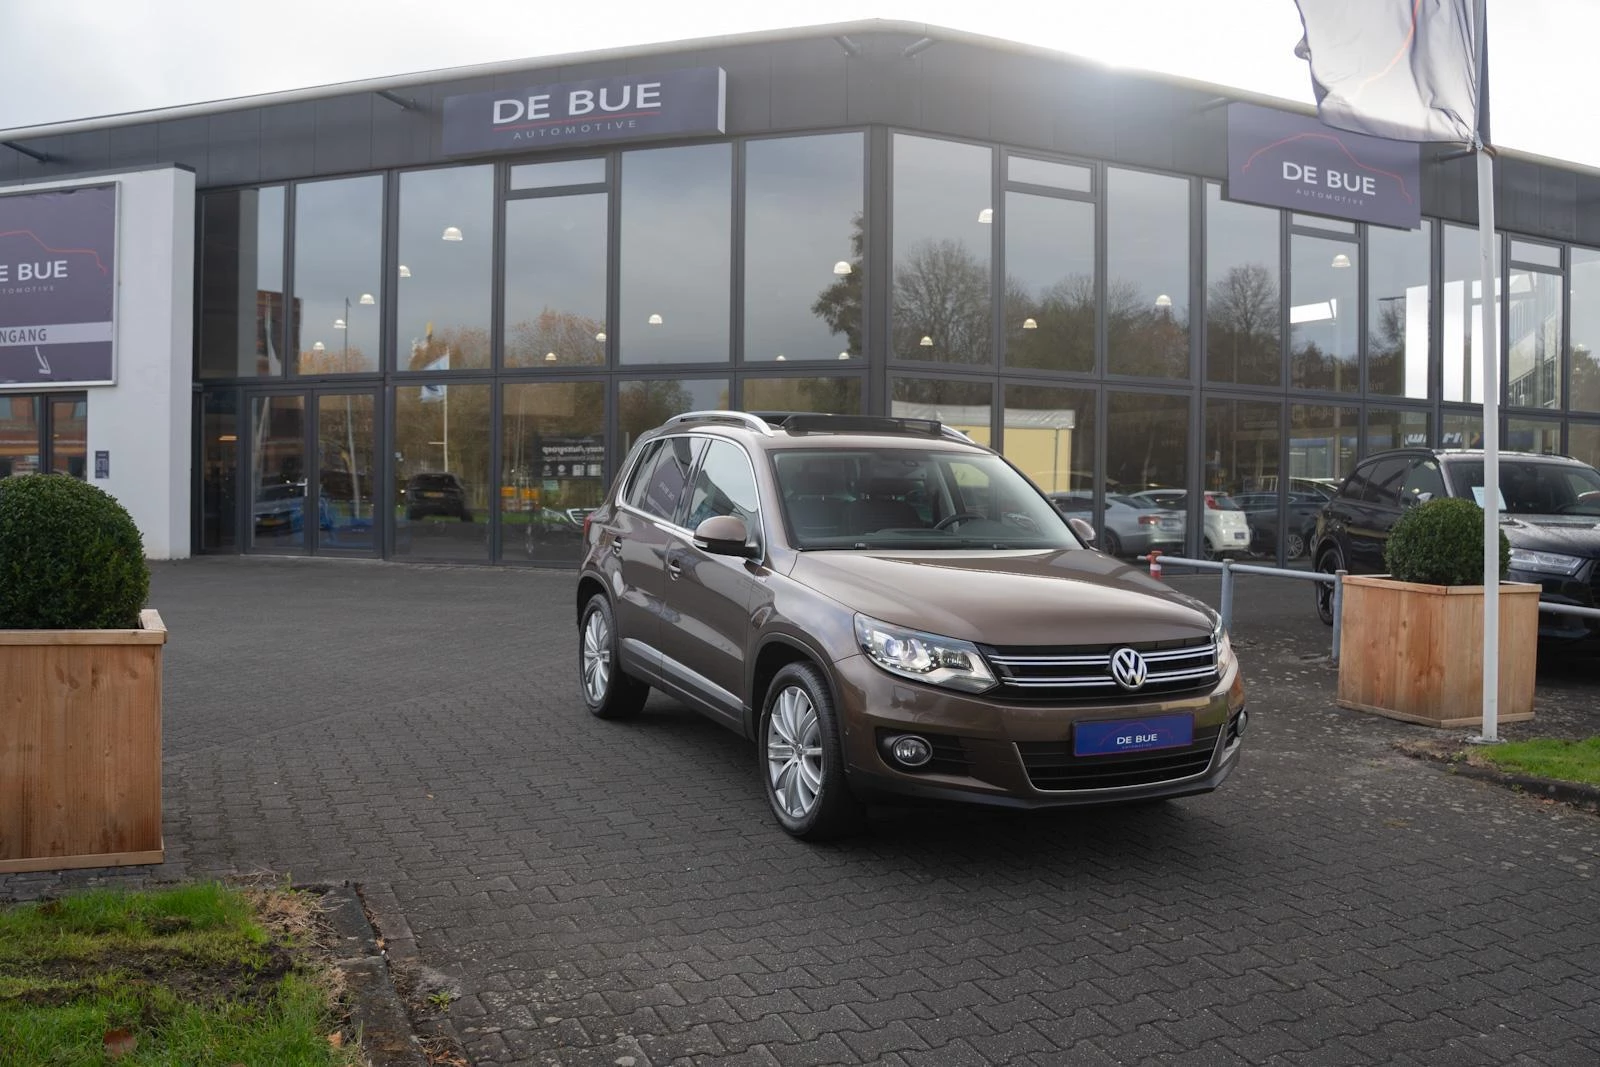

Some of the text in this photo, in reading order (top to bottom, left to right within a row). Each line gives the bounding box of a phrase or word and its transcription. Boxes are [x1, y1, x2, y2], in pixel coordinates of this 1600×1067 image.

[493, 82, 662, 124] DE BUE
[513, 120, 637, 140] AUTOMOTIVE
[1282, 161, 1376, 195] DE BUE
[1296, 188, 1363, 206] AUTOMOTIVE
[0, 260, 68, 282] E BUE
[0, 284, 54, 295] TOMOTIVE
[0, 328, 47, 344] NGANG
[1116, 733, 1158, 745] DE BUE
